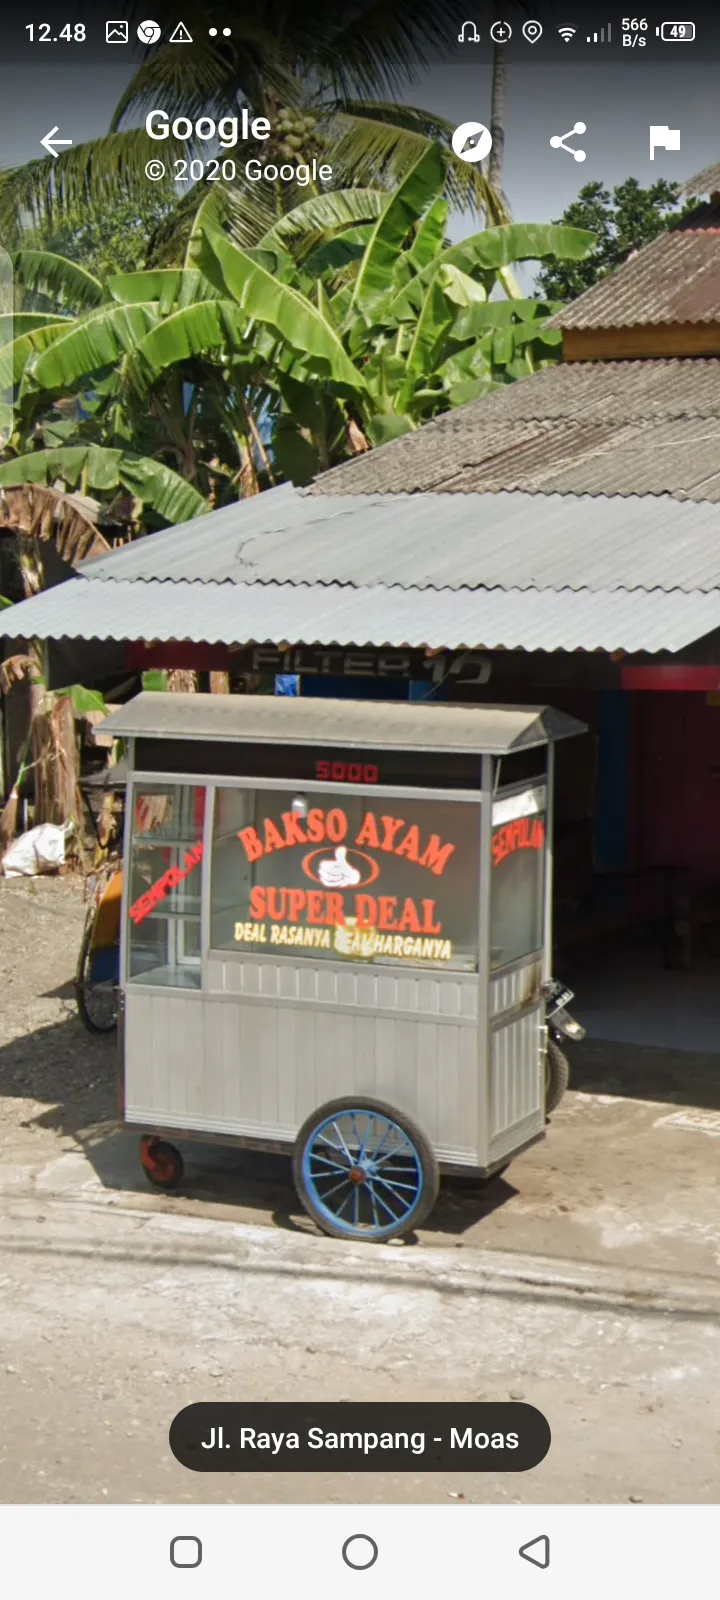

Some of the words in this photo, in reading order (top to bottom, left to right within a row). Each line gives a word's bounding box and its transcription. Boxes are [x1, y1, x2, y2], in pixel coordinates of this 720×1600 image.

[252, 650, 410, 677] FILTER
[237, 808, 348, 863] BAKSO
[355, 811, 455, 876] AYAM
[249, 886, 345, 926] SUPER
[355, 894, 441, 934] DEAL
[234, 922, 267, 943] DEAL
[270, 925, 331, 949] RASANYA
[374, 933, 452, 960] HARGANYA
